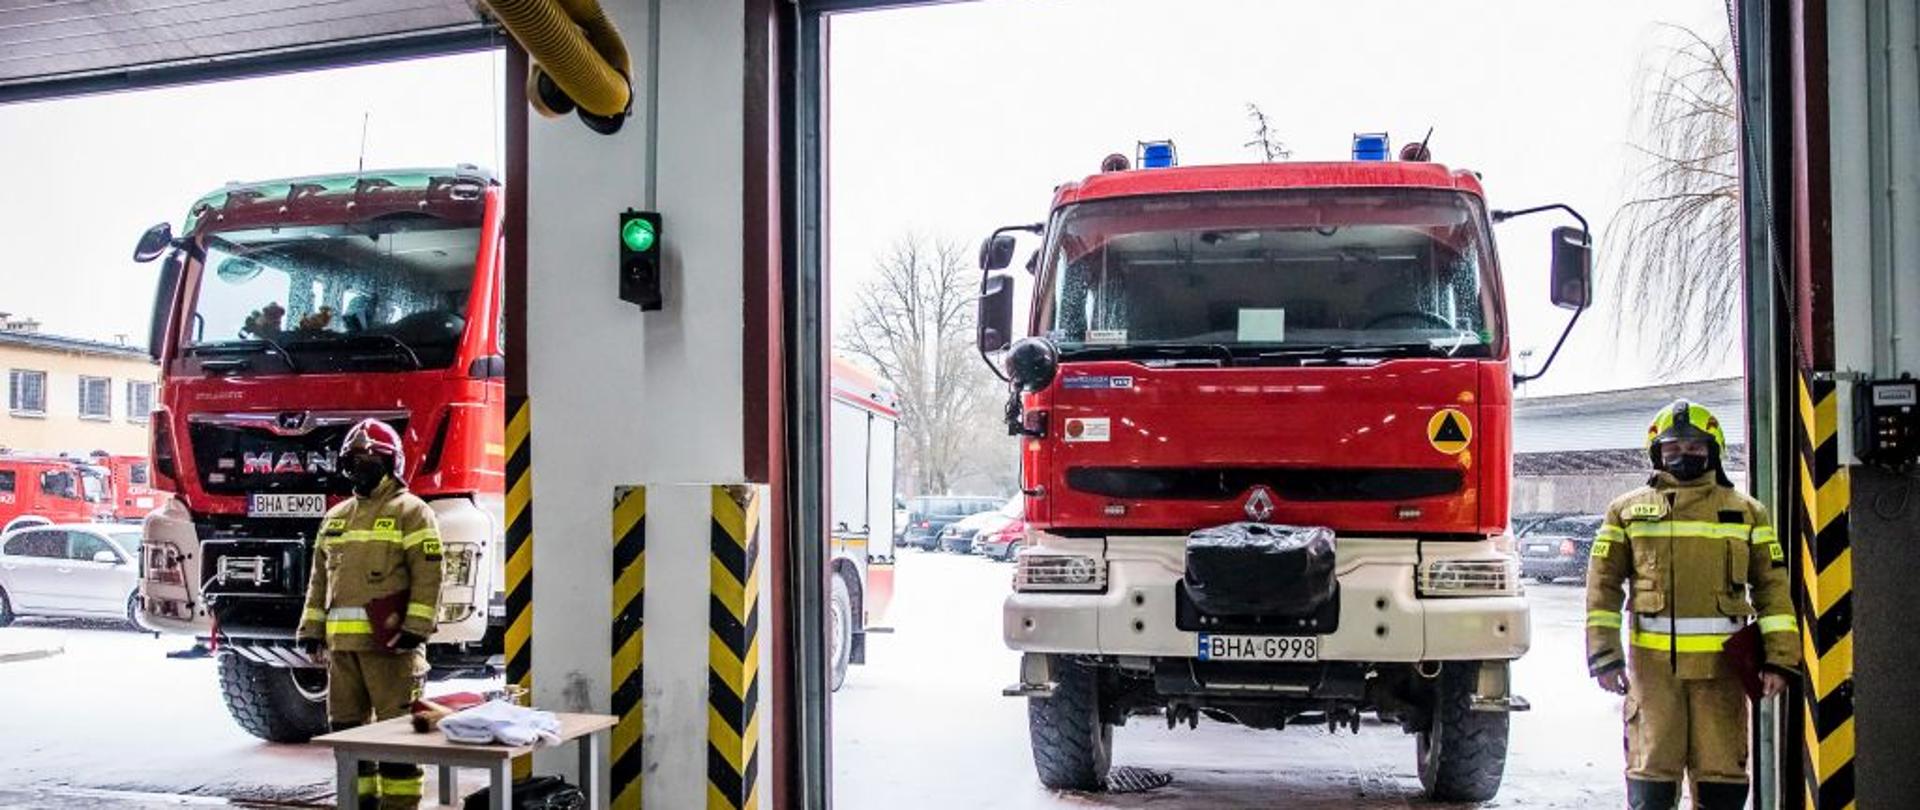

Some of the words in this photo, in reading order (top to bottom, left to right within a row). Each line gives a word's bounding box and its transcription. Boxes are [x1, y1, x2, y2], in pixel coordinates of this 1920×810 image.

[243, 451, 338, 474] MAN
[255, 496, 282, 512] BHA
[287, 496, 323, 512] EM90
[1211, 637, 1256, 658] BHA
[1263, 638, 1316, 659] G998
